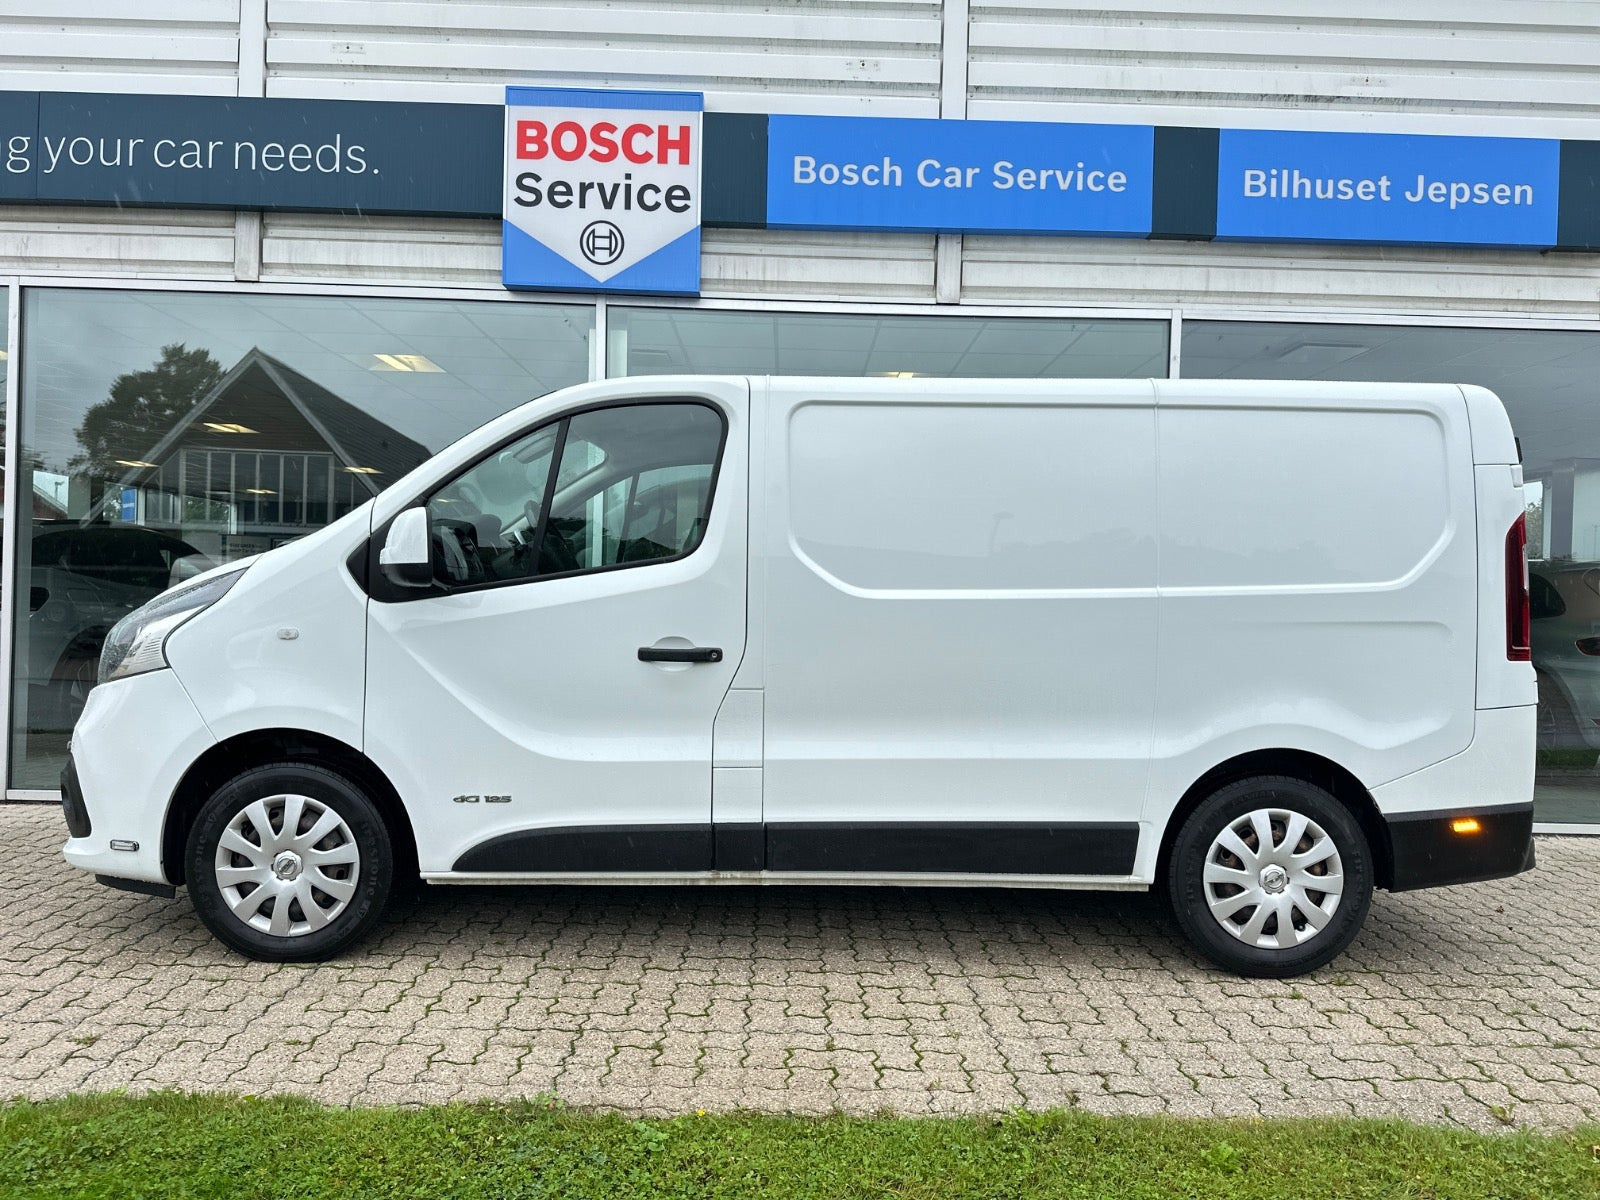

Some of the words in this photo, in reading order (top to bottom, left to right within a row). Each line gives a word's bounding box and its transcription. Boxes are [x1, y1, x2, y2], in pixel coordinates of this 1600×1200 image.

[2, 136, 31, 174] g
[43, 136, 144, 174] your
[153, 139, 224, 169] car
[234, 133, 380, 175] needs.
[516, 120, 691, 166] BOSCH
[513, 171, 692, 214] Service
[792, 155, 903, 188] Bosch
[916, 158, 980, 189] Car
[992, 160, 1128, 194] Service
[1243, 167, 1392, 202] Bilhuset
[1404, 173, 1535, 211] Jepsen
[484, 795, 513, 804] 125
